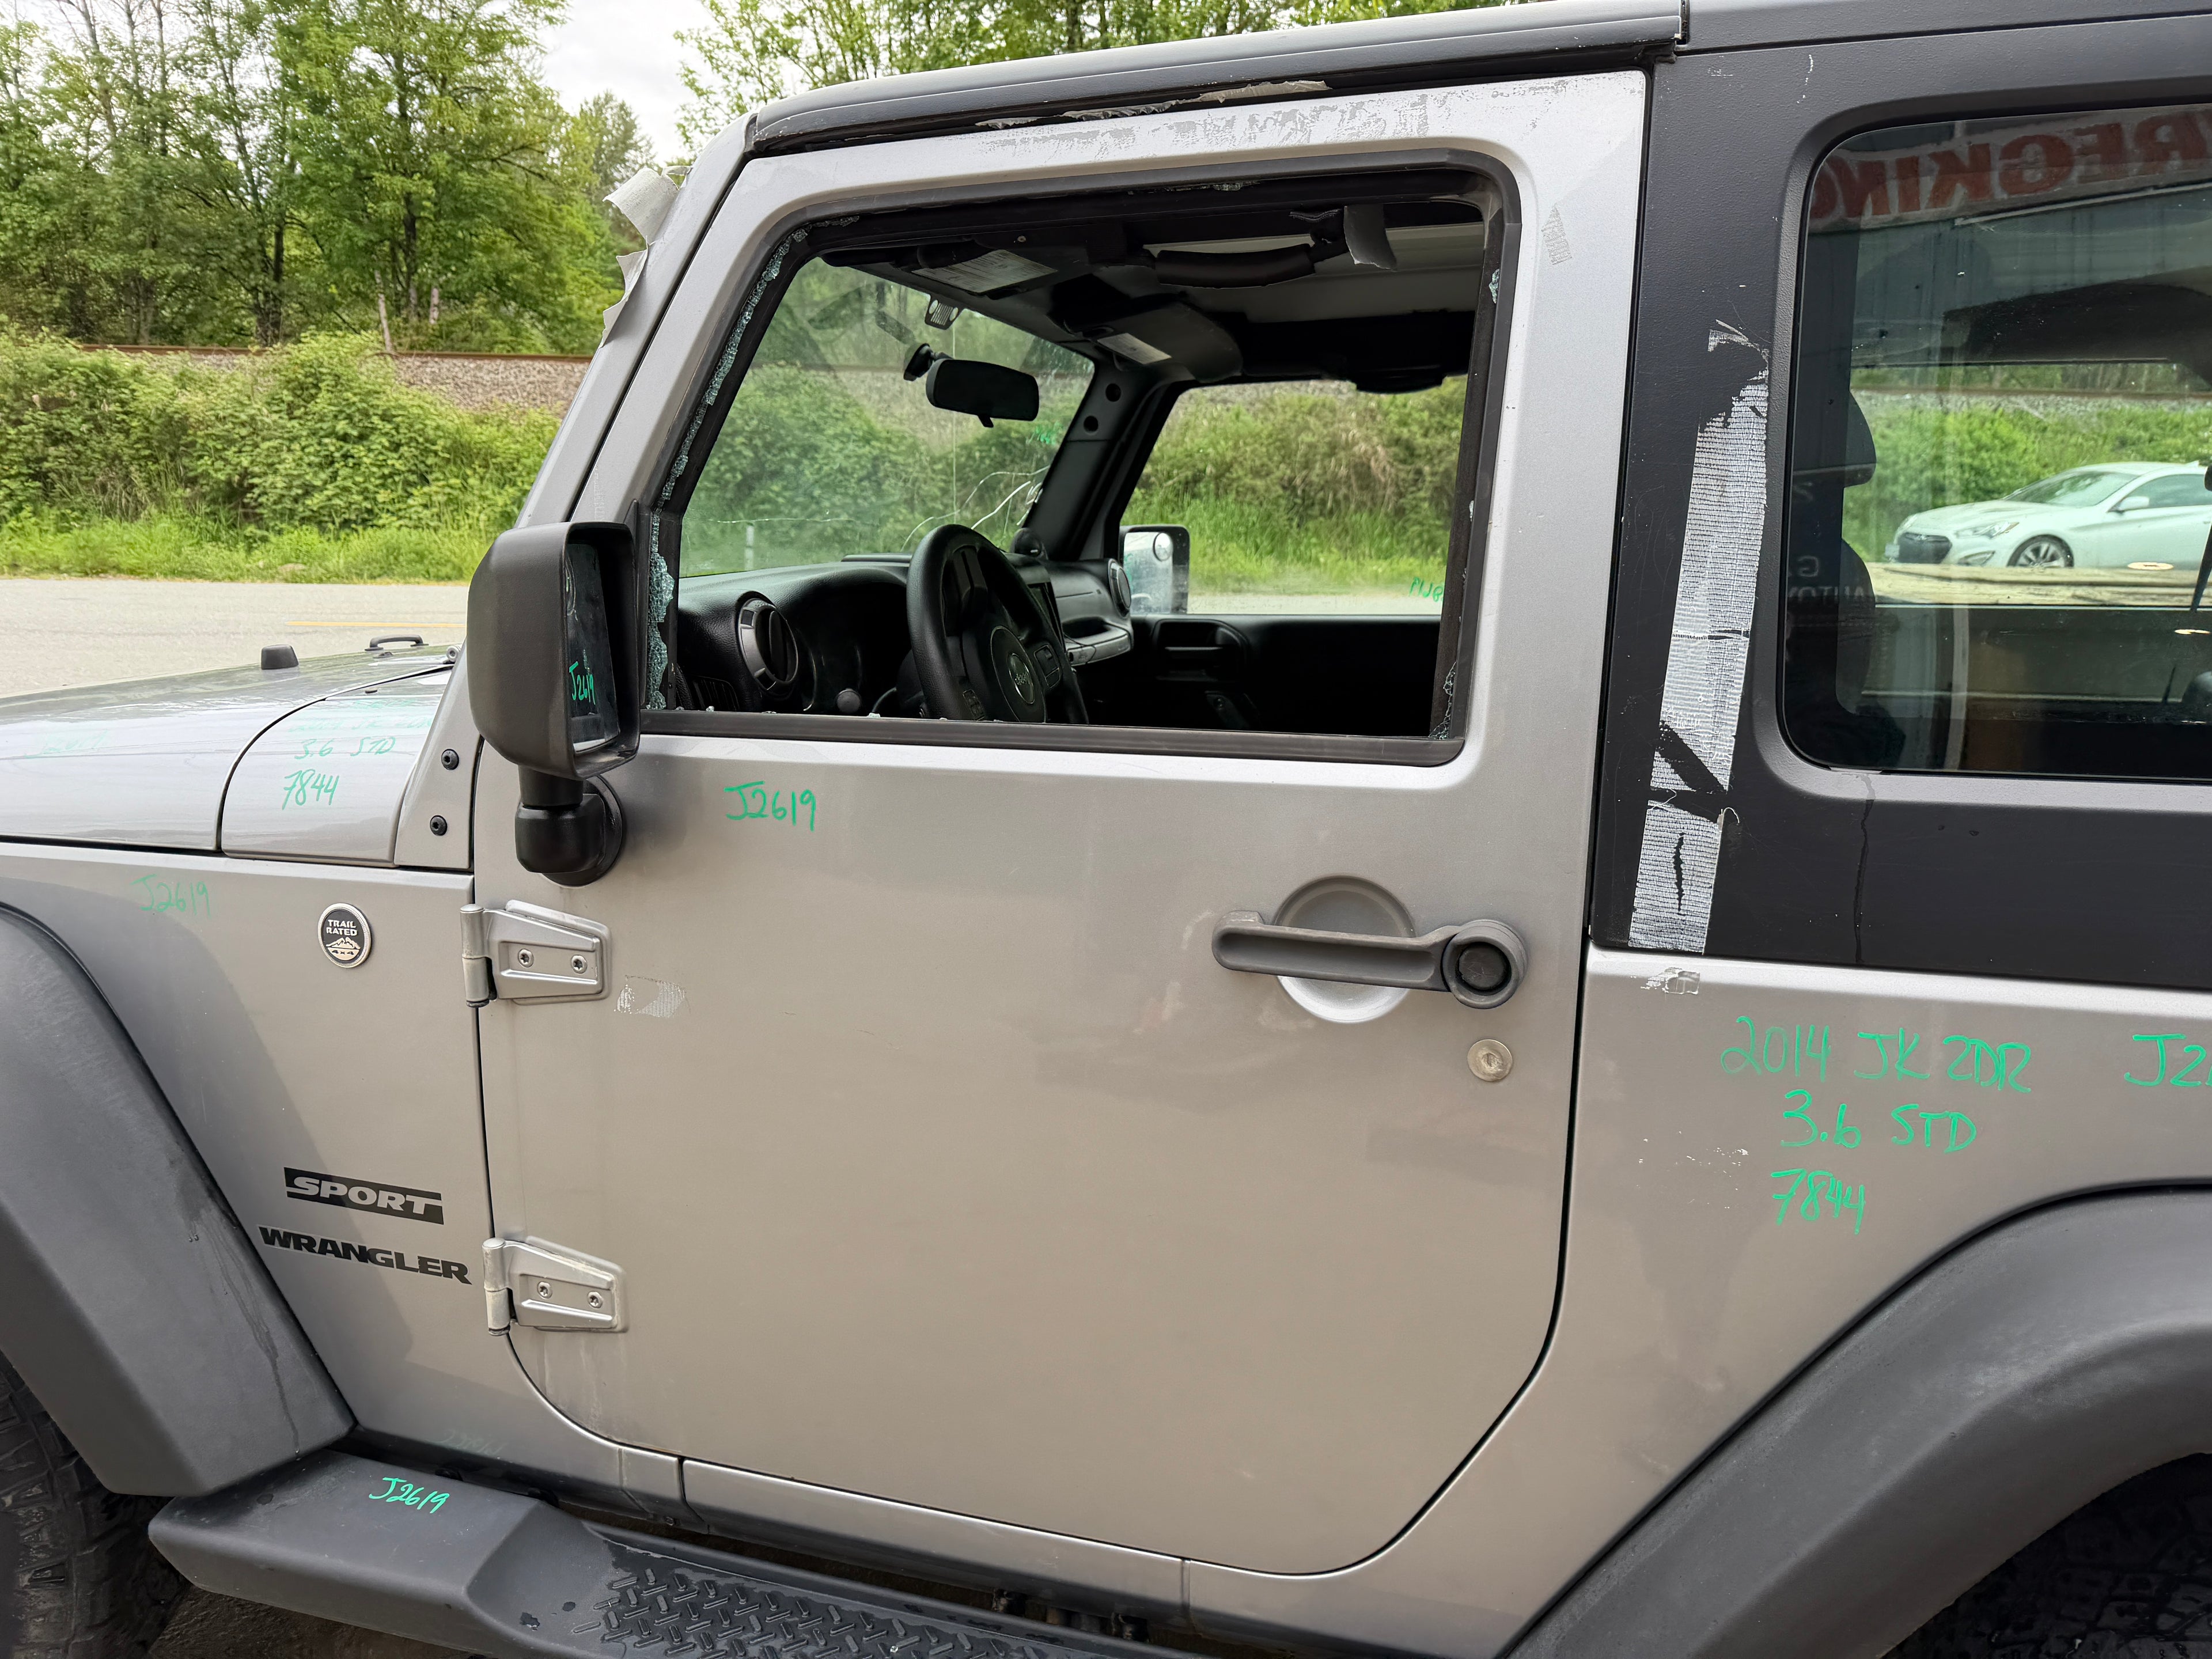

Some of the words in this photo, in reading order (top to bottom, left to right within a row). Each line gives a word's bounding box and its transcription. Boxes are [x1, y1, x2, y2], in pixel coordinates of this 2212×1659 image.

[294, 738, 334, 760] 3.6
[350, 736, 396, 757] STD
[282, 768, 340, 810] 7844
[724, 780, 817, 832] J2619
[130, 873, 212, 917] J2619
[326, 927, 358, 936] RATED
[328, 919, 357, 928] TRAIL
[1720, 1016, 1831, 1082] 2014
[1854, 1027, 1931, 1081] JK
[1941, 1034, 2032, 1093] 2DR
[2124, 1033, 2212, 1088] J2
[1780, 1089, 1862, 1149] 3.6
[1891, 1103, 1977, 1154] STD
[286, 1176, 442, 1215] SPORT
[1770, 1168, 1866, 1236] 7844
[258, 1226, 472, 1285] WRANGLER
[369, 1476, 450, 1514] J2619
